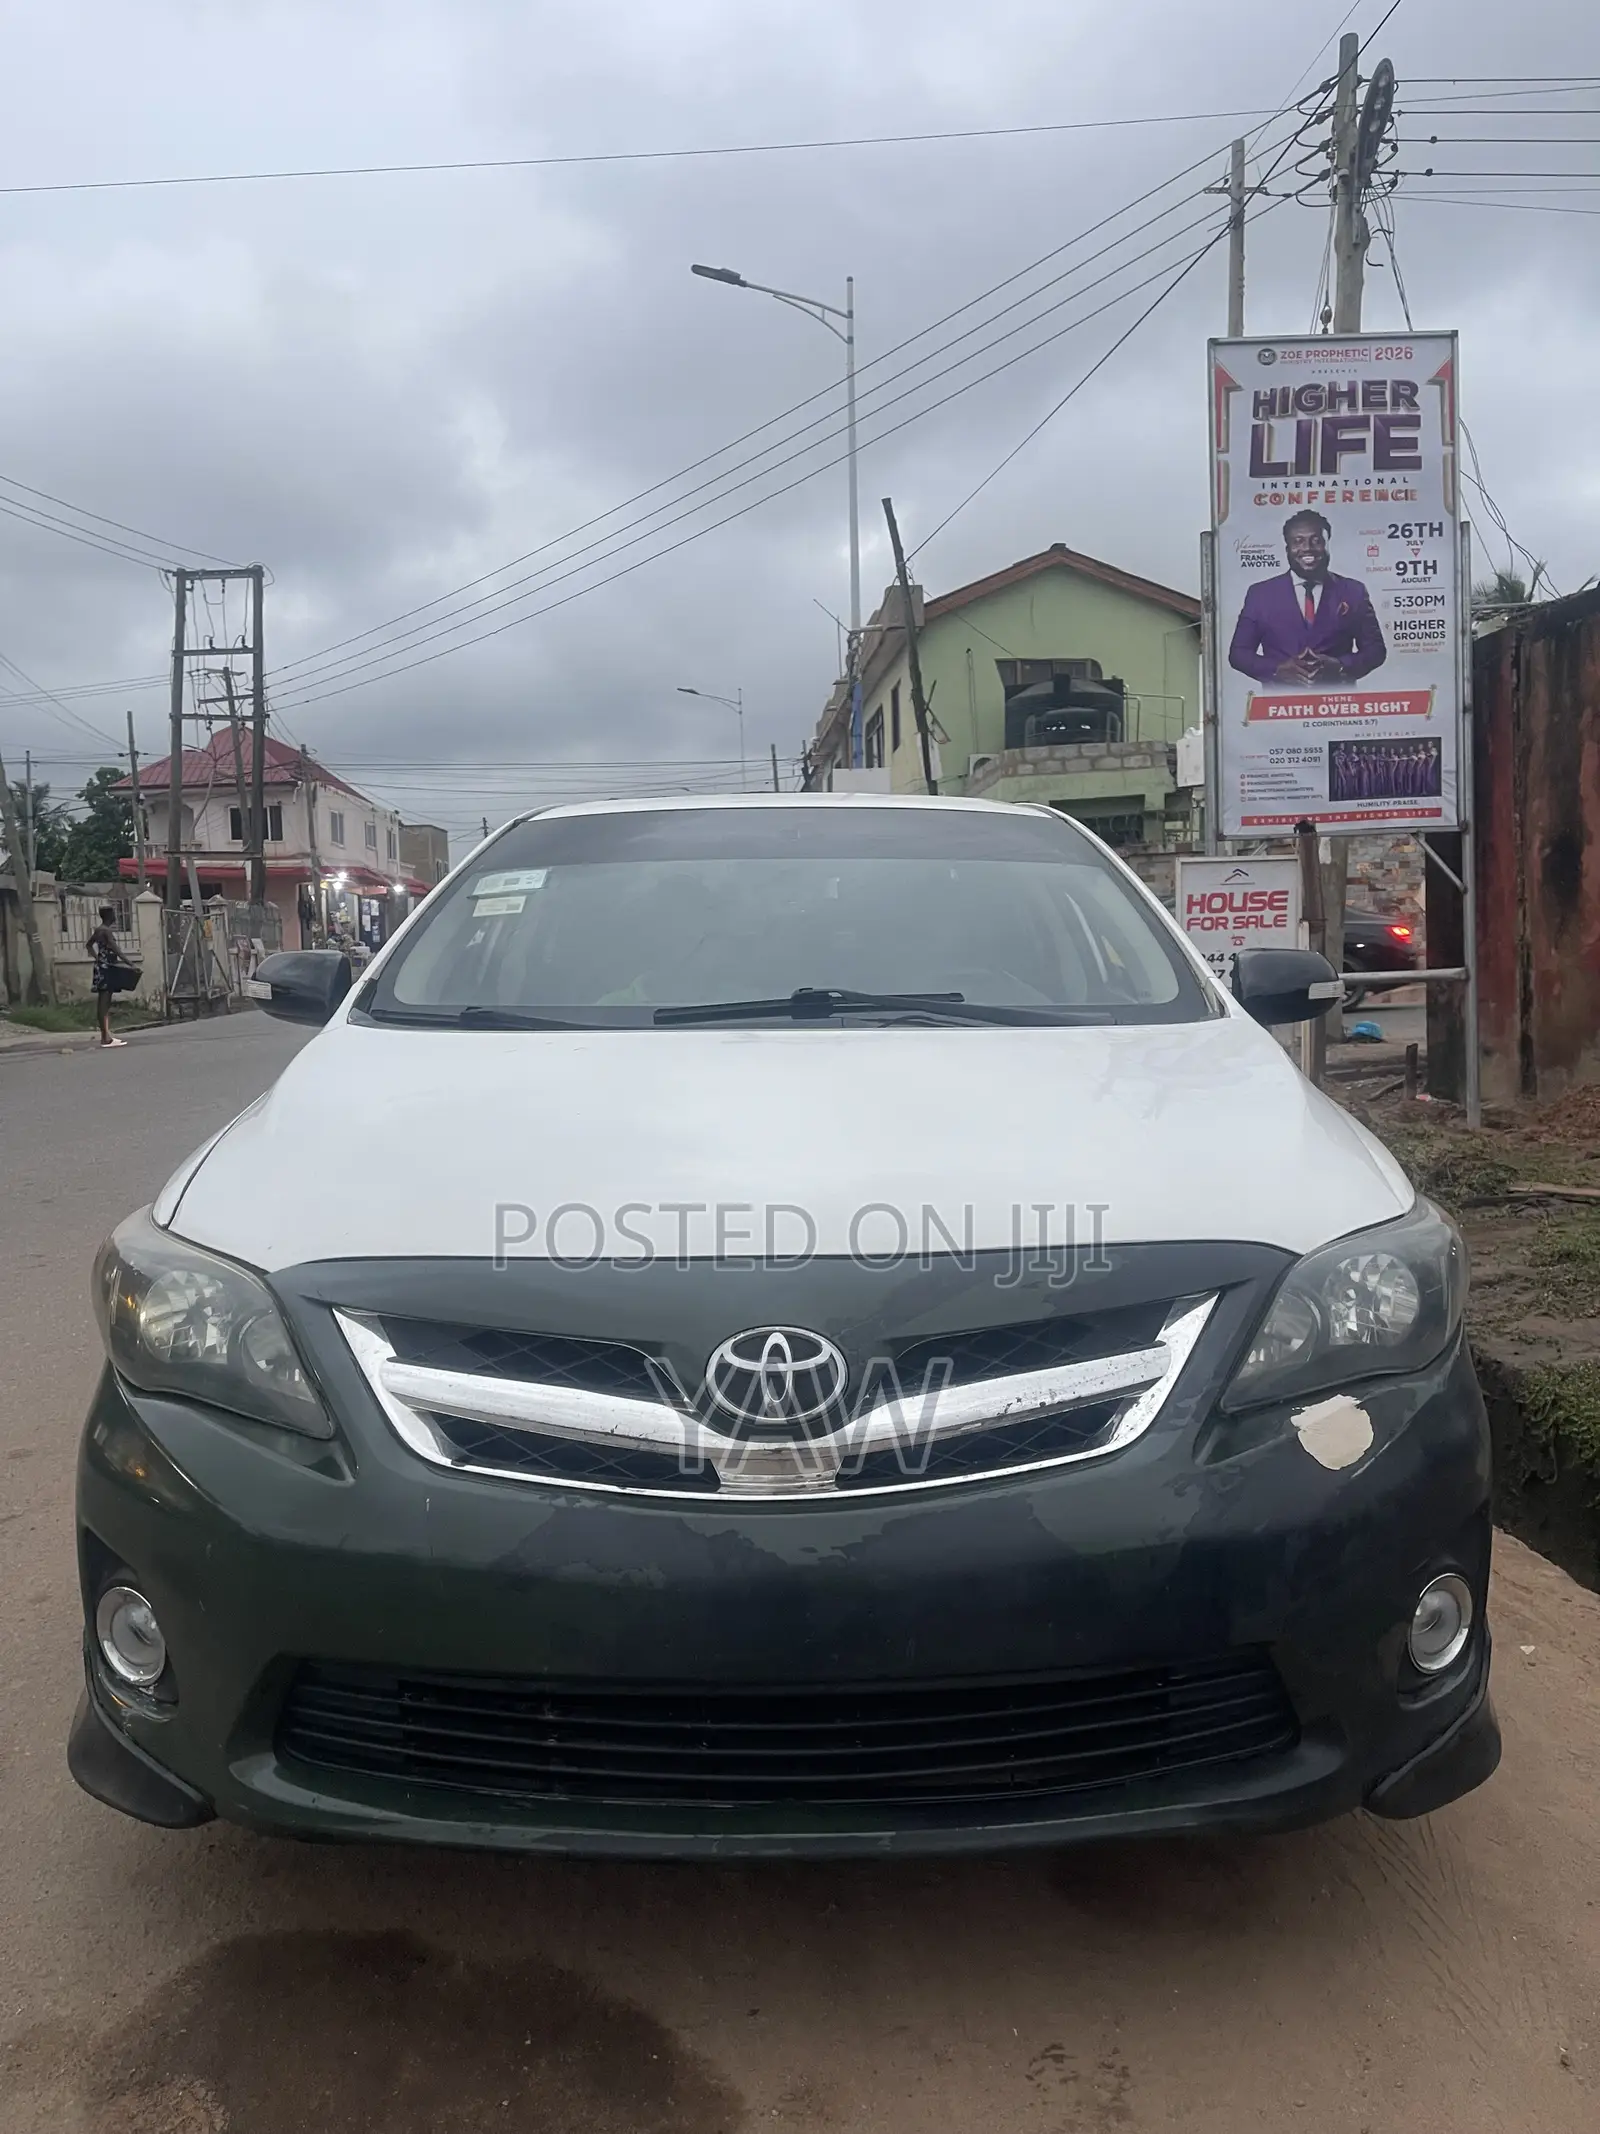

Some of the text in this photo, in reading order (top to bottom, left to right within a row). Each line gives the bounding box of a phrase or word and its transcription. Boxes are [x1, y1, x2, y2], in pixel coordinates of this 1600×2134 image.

[1280, 346, 1414, 361] ZOE PROPHETIC 2026
[1252, 379, 1421, 421] HIGHER
[1249, 413, 1423, 478] LIFE
[1261, 477, 1409, 489] INTERNATIONAL
[1253, 489, 1418, 506] CONFERENCE
[1387, 521, 1444, 539] 26TH
[1240, 560, 1281, 568] AWOTWE
[1395, 559, 1438, 576] 9TH
[1393, 594, 1446, 608] 5:30PM
[1393, 619, 1446, 631] HIGHER
[1393, 630, 1446, 641] GROUNDS
[1268, 701, 1411, 717] FAITH OVER SIGHT
[1311, 719, 1363, 728] CORINTHIANS
[1357, 800, 1390, 808] HUMILITY
[1186, 890, 1289, 914] HOUSE
[1186, 914, 1288, 931] FOR SALE
